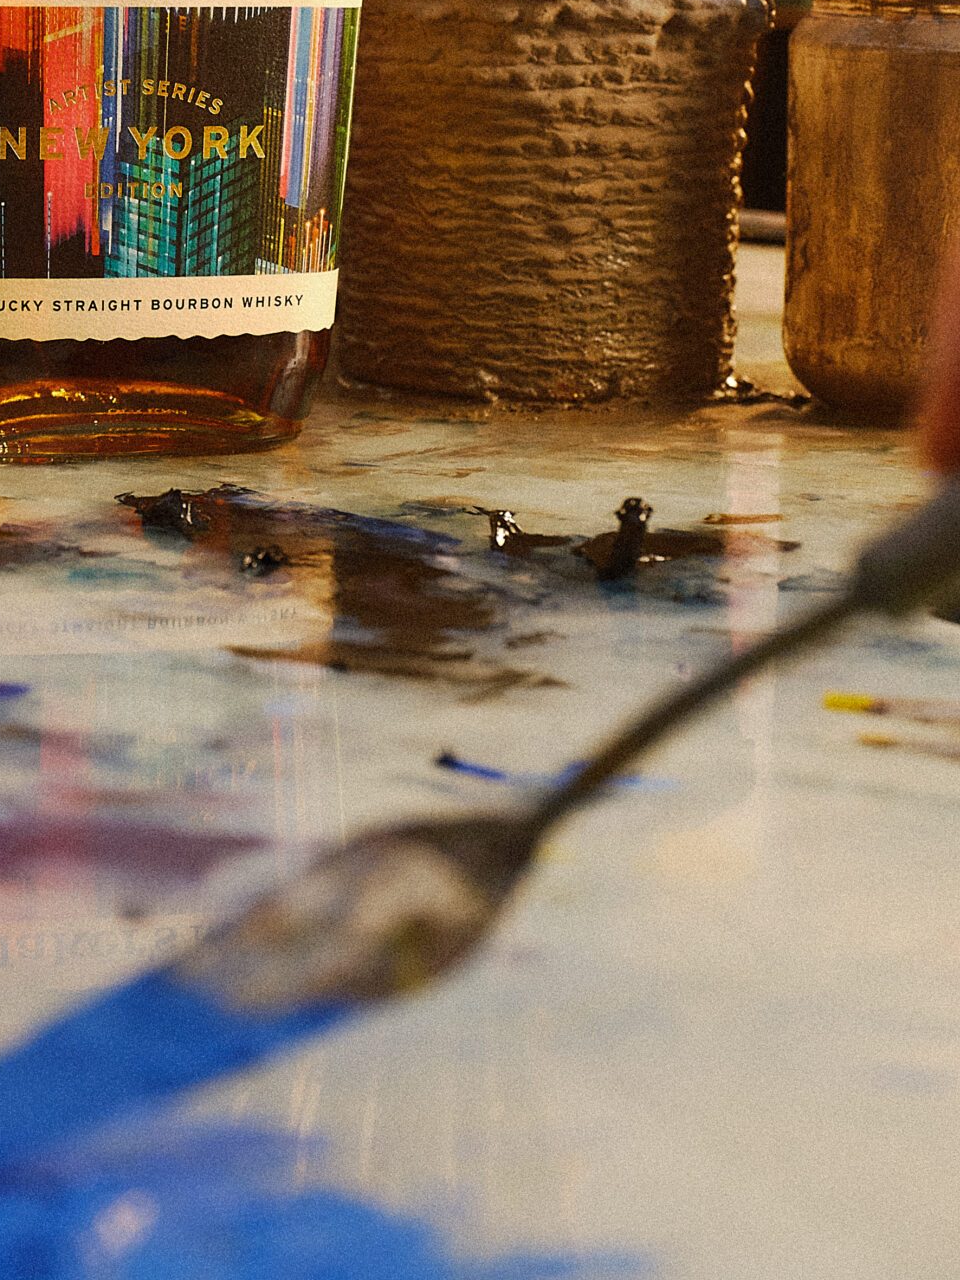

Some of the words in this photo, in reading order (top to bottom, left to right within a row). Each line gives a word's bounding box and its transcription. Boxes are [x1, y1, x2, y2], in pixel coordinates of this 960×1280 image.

[48, 78, 132, 115] ARTIST
[142, 78, 224, 115] SERIES
[127, 124, 266, 160] YORK
[83, 181, 184, 199] EDITION
[52, 299, 143, 312] STRAIGHT
[150, 297, 234, 311] BOURBON
[242, 294, 304, 308] WHISKY
